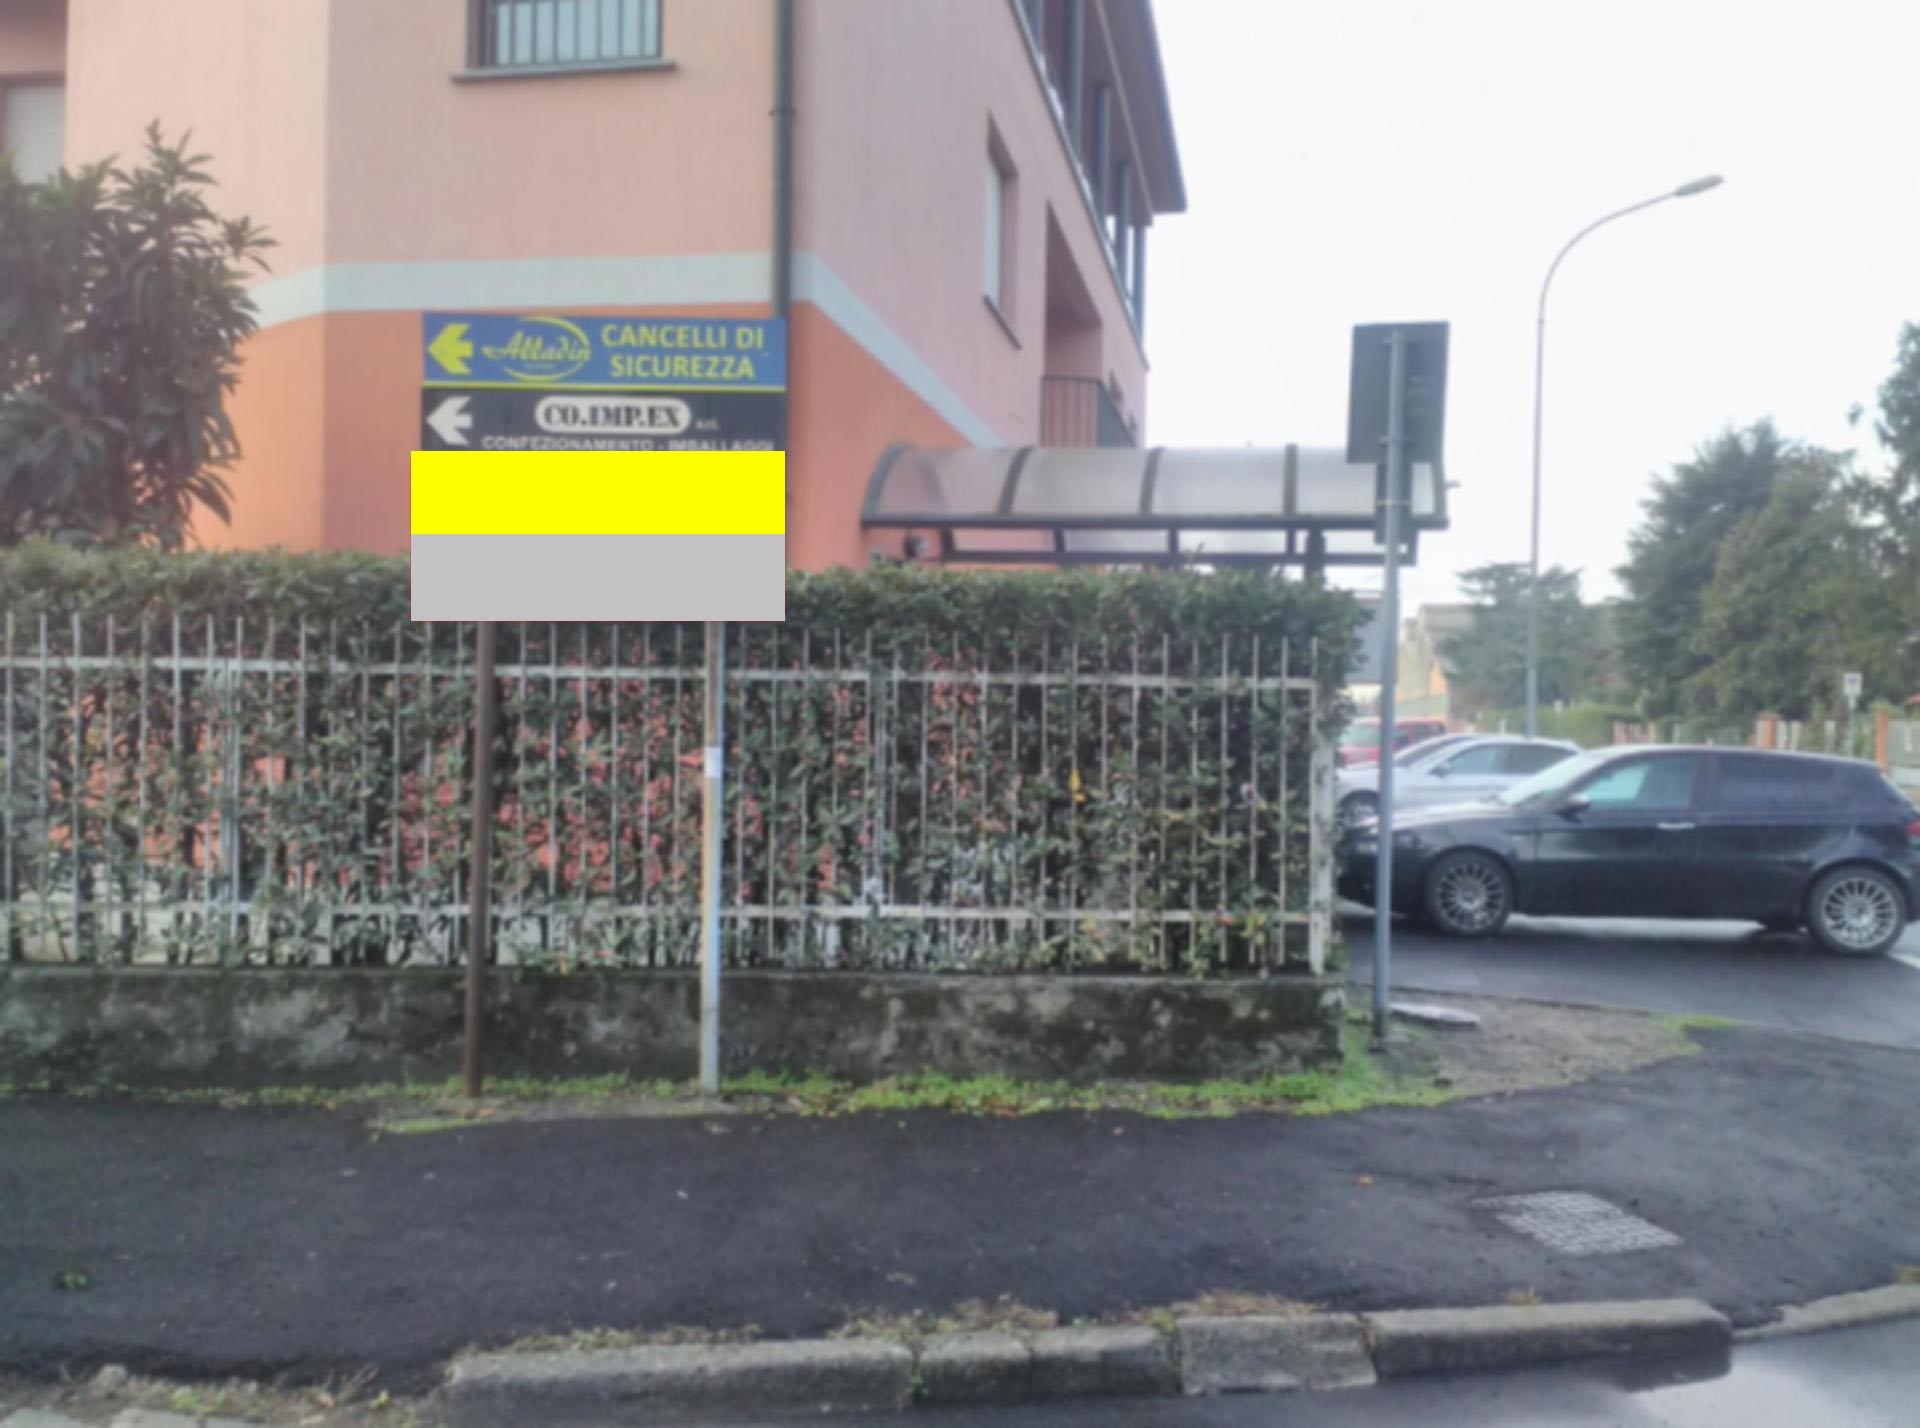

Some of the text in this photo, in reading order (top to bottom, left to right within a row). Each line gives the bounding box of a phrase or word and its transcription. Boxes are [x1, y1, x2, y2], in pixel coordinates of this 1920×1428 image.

[602, 323, 764, 350] CANCELLI DI
[610, 354, 755, 379] SICUREZZA
[543, 402, 681, 428] CO.IMP.EX
[482, 434, 652, 451] CONFEZIONAMENTO
